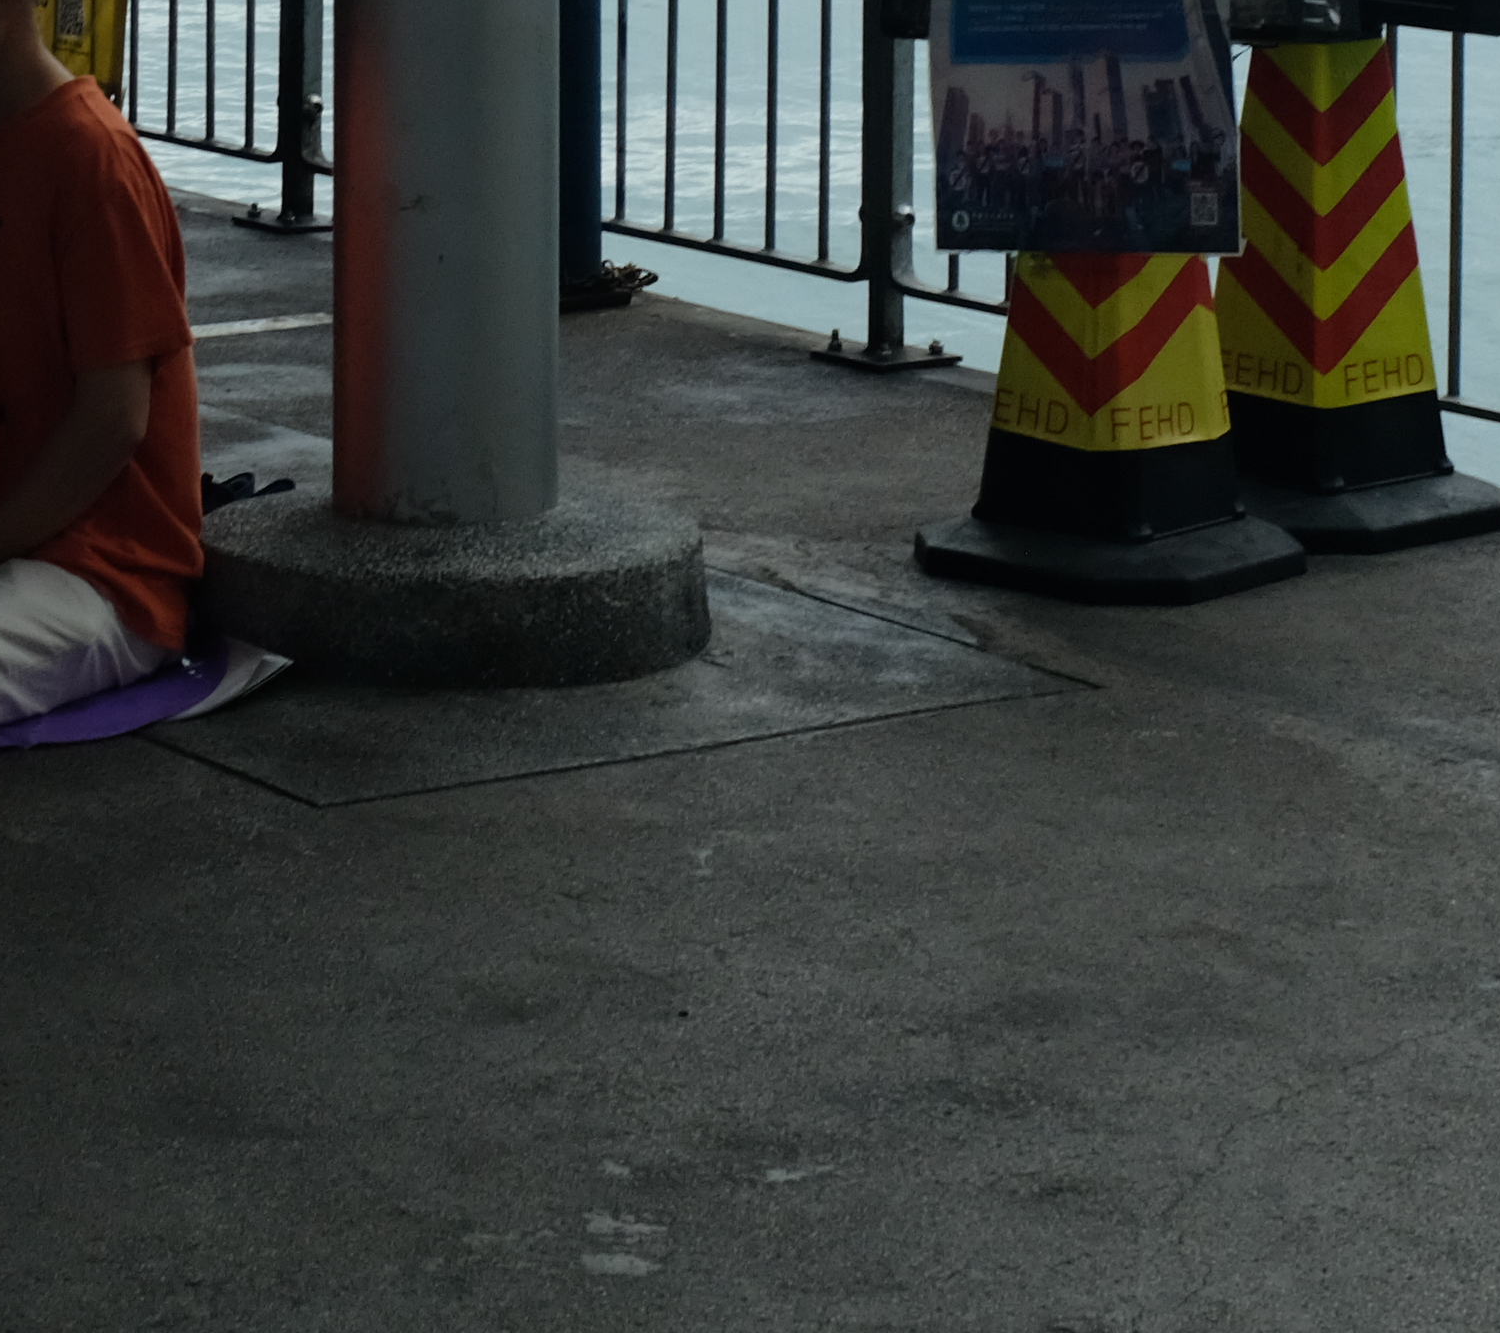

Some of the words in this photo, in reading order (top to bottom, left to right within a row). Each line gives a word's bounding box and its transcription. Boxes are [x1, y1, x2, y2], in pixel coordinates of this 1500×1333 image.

[1343, 353, 1425, 397] FEHD
[992, 387, 1069, 436] EHD
[1110, 402, 1195, 443] FEHD
